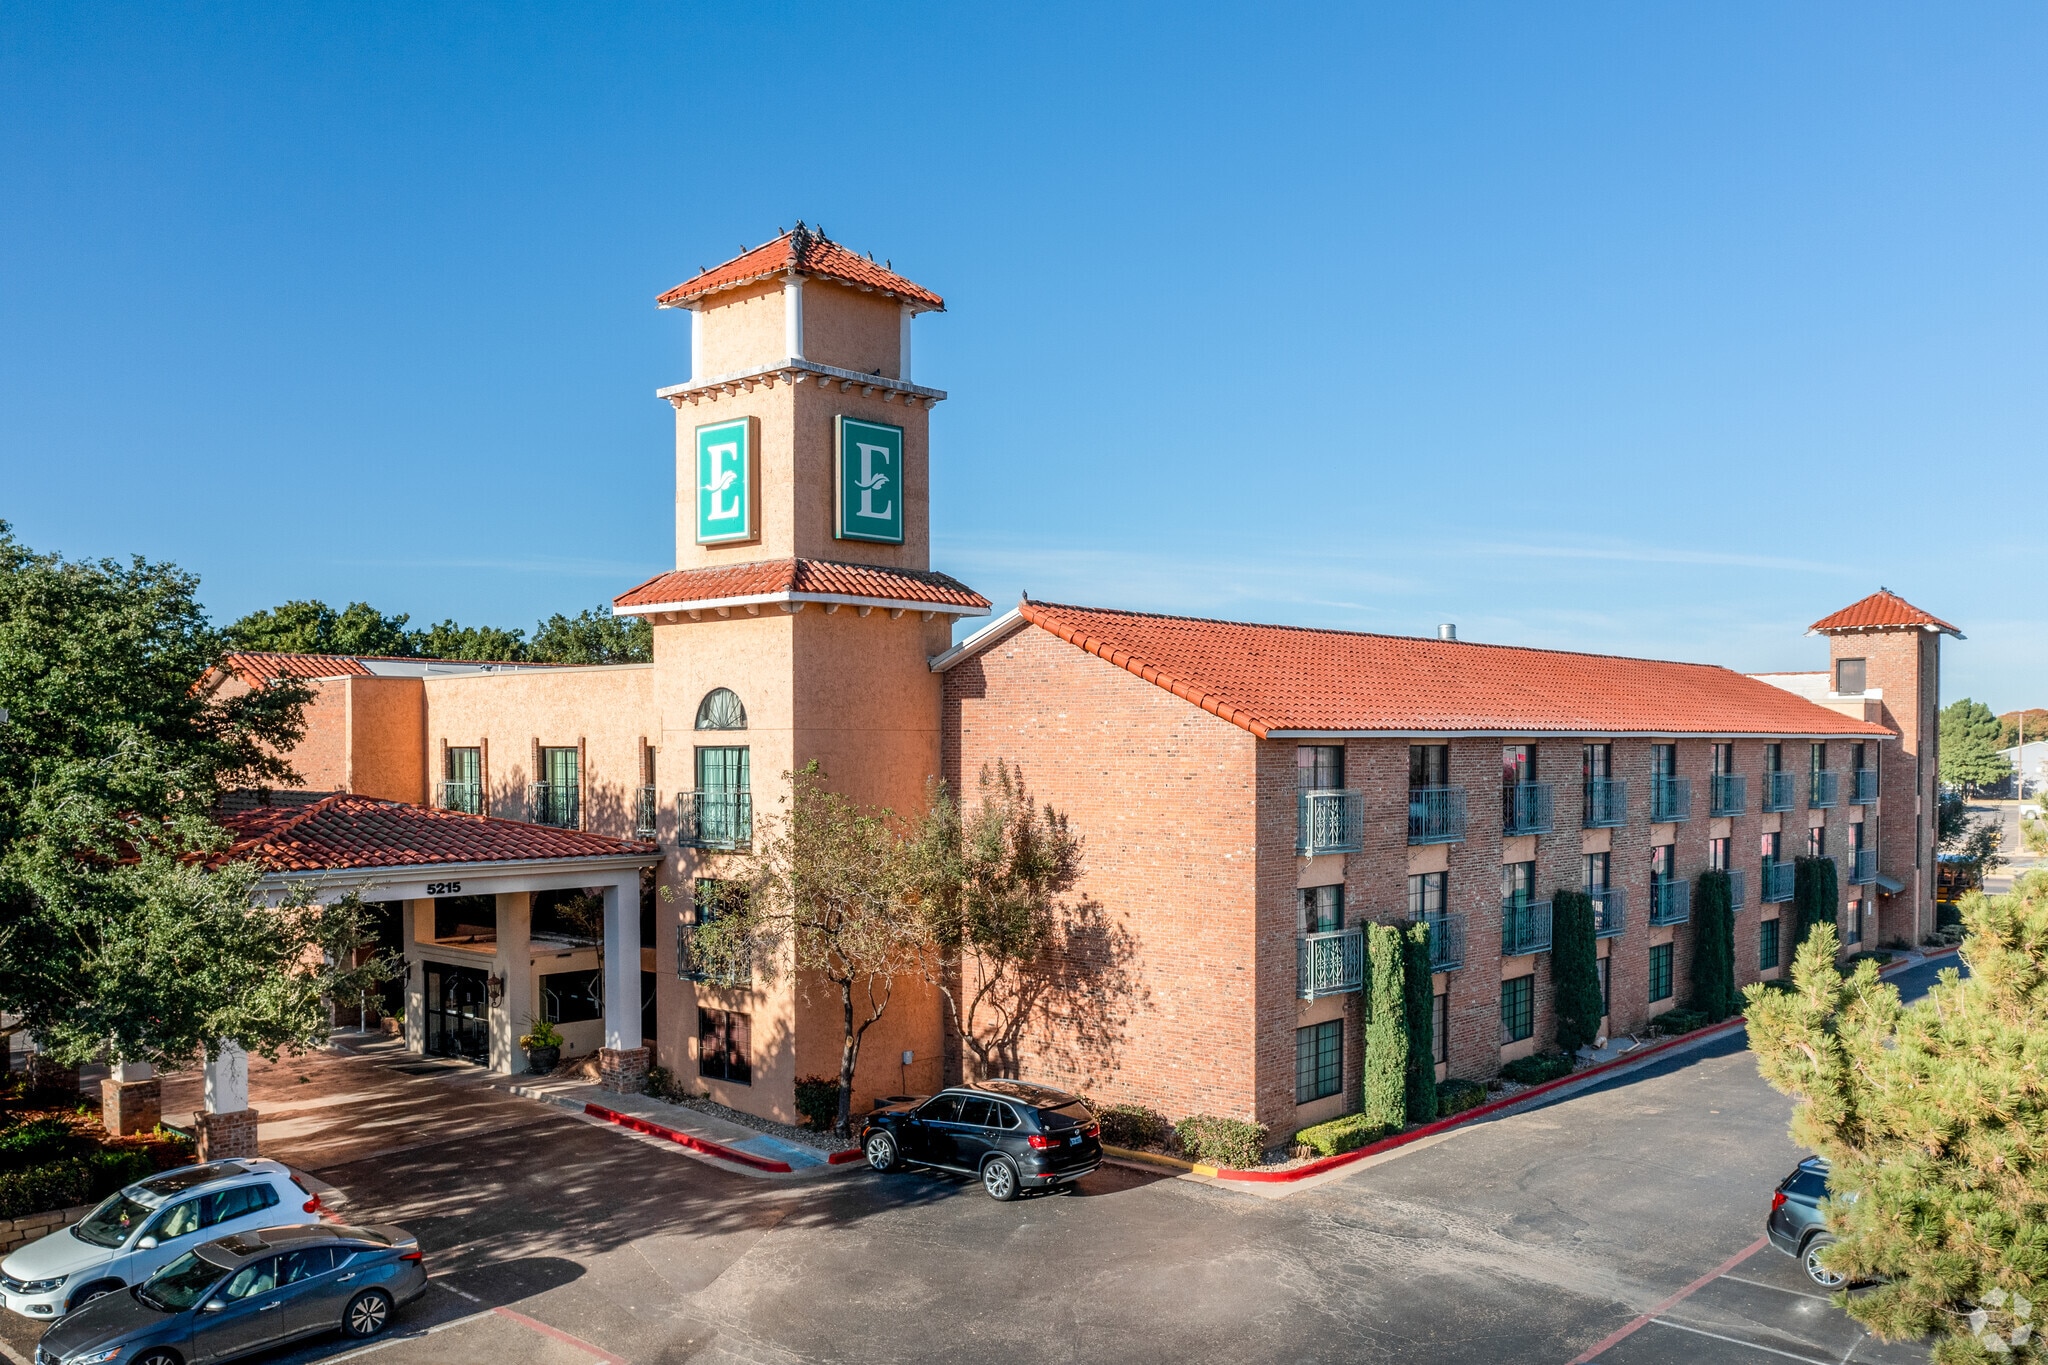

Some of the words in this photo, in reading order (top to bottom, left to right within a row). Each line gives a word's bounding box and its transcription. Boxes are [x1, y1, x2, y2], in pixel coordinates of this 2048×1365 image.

[707, 442, 739, 520] E
[855, 442, 892, 520] E
[427, 881, 461, 895] 5215
